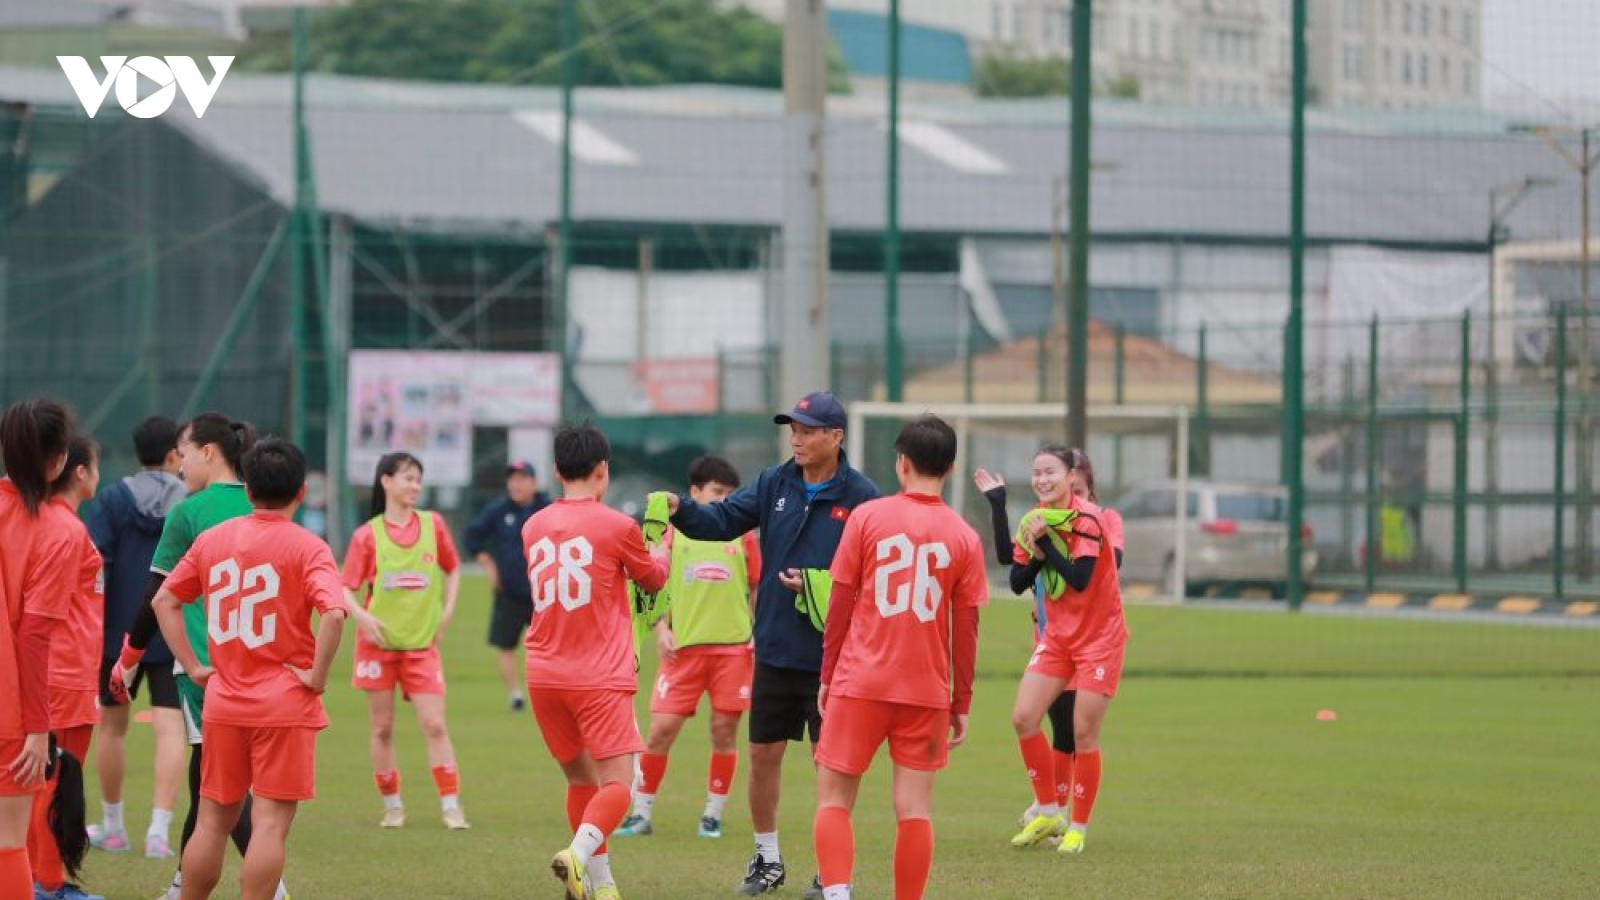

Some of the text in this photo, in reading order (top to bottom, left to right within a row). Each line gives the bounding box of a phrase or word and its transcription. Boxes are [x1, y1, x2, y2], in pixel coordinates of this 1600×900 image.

[207, 556, 281, 650] 22
[529, 535, 593, 613] 28
[875, 532, 952, 623] 26
